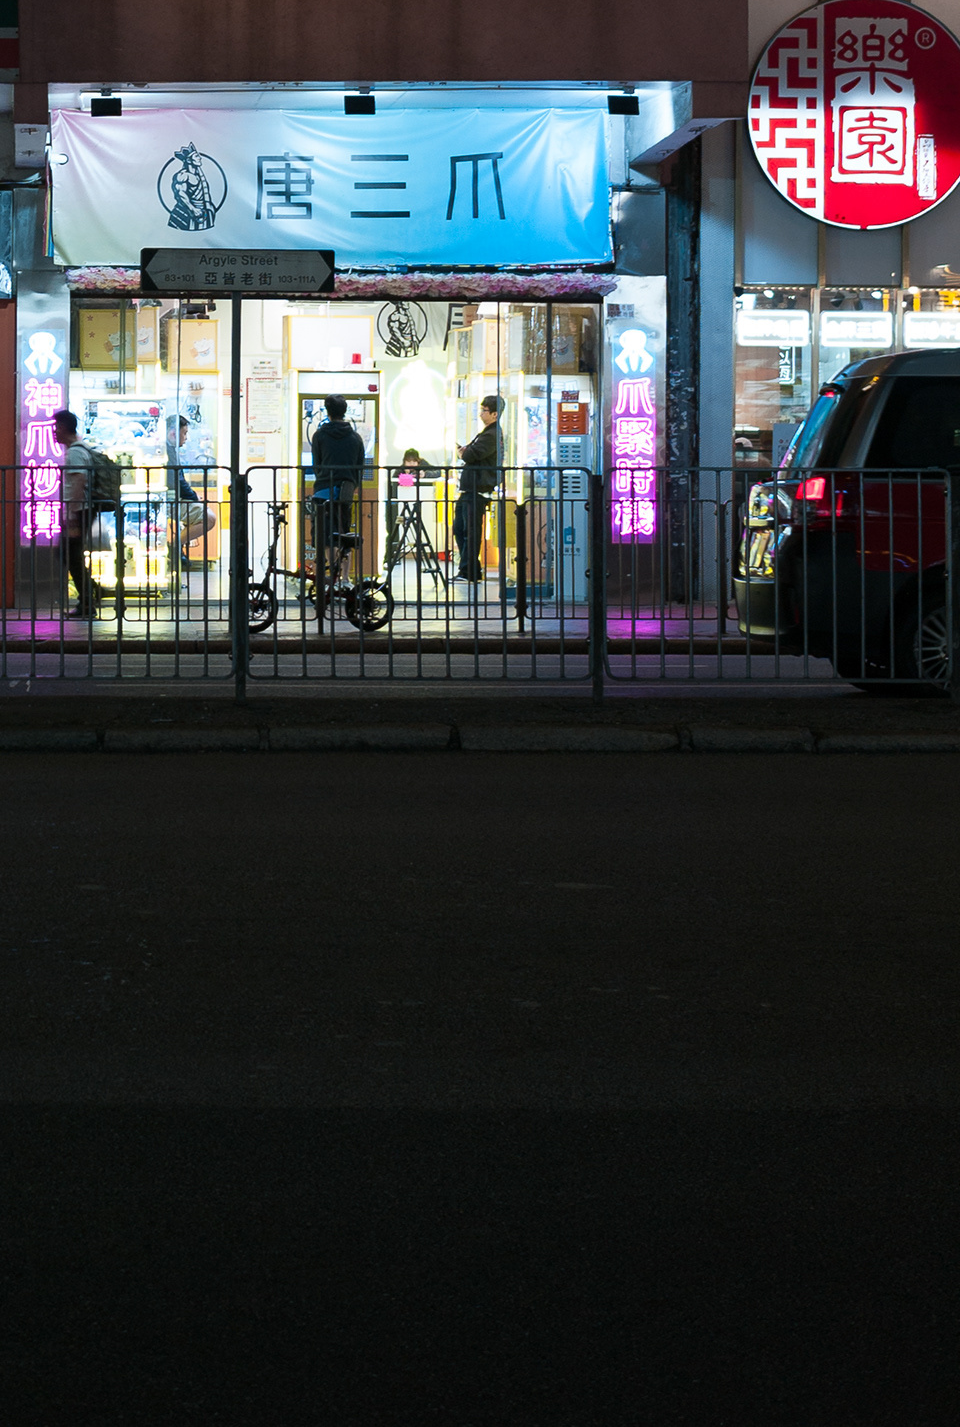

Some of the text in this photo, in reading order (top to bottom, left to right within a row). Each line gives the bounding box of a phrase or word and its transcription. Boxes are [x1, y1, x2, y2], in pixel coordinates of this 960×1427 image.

[835, 23, 910, 175] 樂園
[255, 152, 506, 221] 唐三爪
[164, 272, 316, 286] 83-101 亞皆老街 103-111A
[199, 254, 278, 267] Argyle Street
